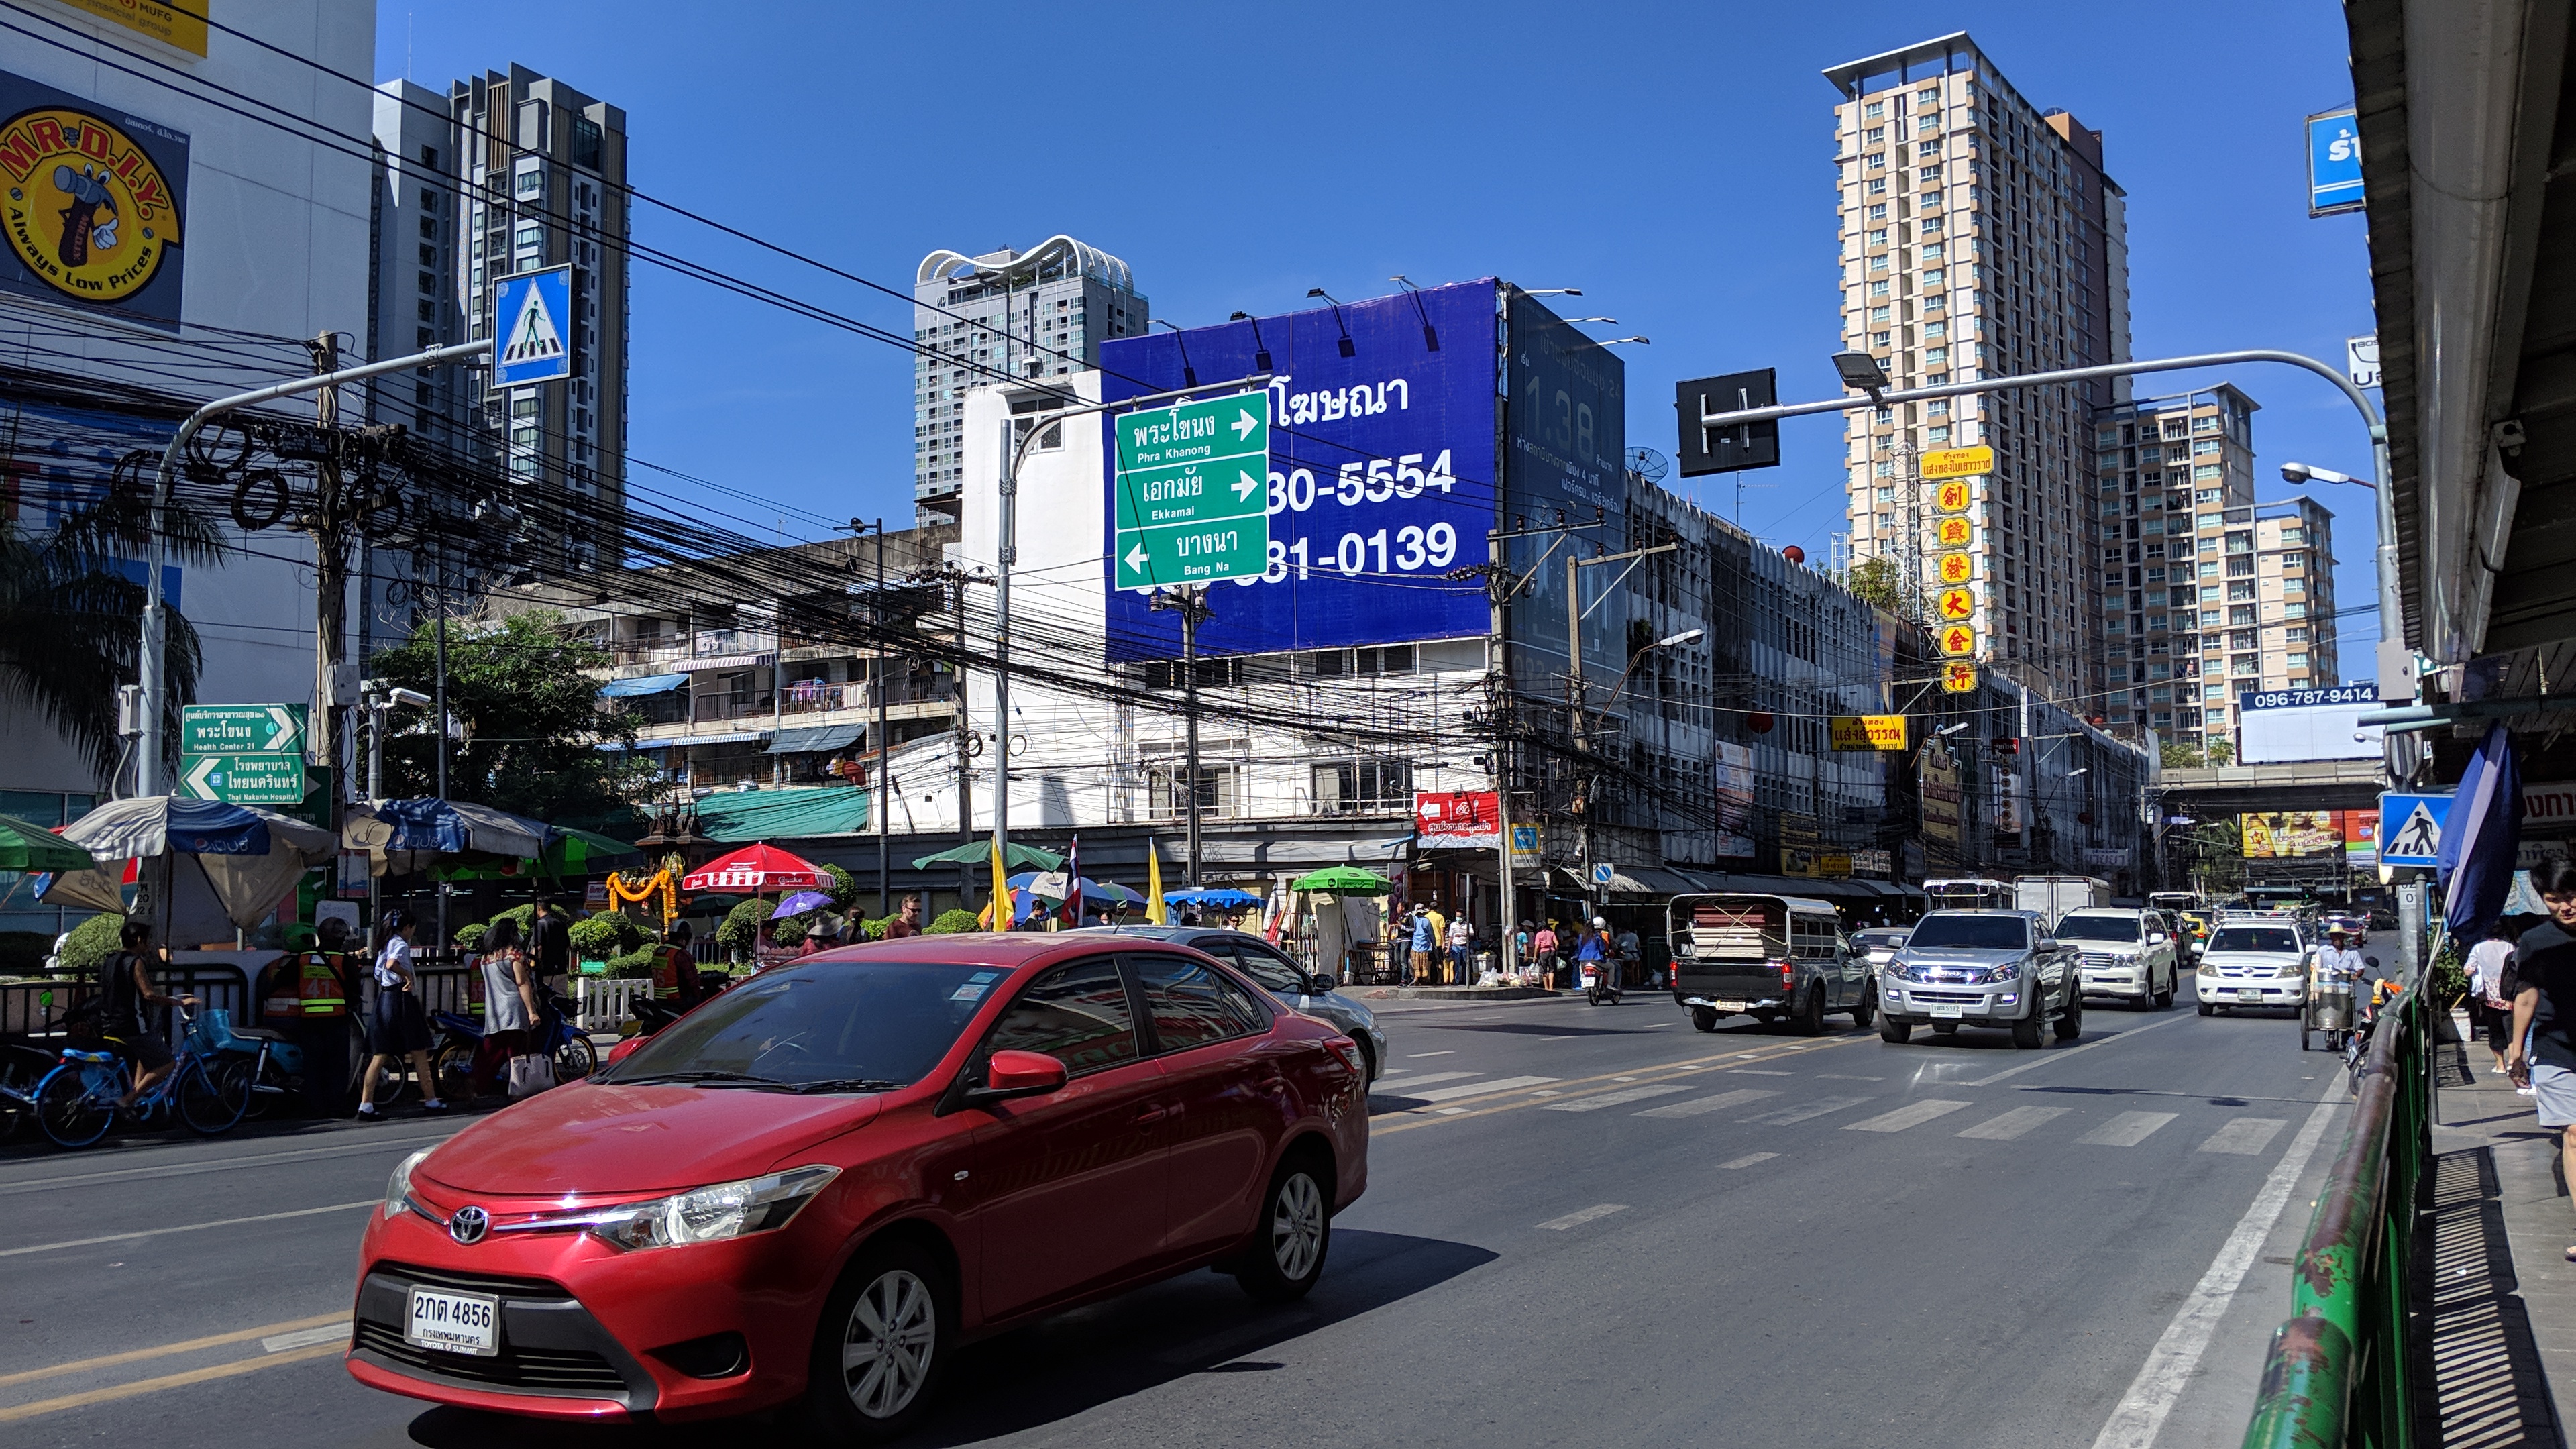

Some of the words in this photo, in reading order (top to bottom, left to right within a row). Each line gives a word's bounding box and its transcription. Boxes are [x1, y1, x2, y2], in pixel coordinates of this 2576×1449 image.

[139, 3, 172, 22] MUFG
[138, 18, 172, 36] group
[9, 207, 59, 276] Always
[65, 271, 103, 291] Low
[108, 246, 152, 289] Prices
[1268, 374, 1409, 428] โฆษณา
[1134, 407, 1215, 447] พระโขนง
[1526, 375, 1594, 464] 1.38
[1138, 449, 1160, 464] Phra
[1165, 445, 1210, 460] Khanong
[1943, 452, 1969, 460] ห้างทอง
[1144, 466, 1202, 502] เอกมัย
[1152, 505, 1195, 520] Ekkamai
[1176, 531, 1238, 557] บางนา
[1184, 563, 1210, 576] Bang
[1216, 561, 1229, 572] Na
[2255, 688, 2373, 708] 096-787-9414
[197, 720, 251, 738] พระโขนง
[233, 757, 290, 771] โรงพยาบาล
[227, 771, 299, 789] ไทยนครินทร์
[227, 794, 241, 802] Thai
[270, 794, 297, 802] Hospital
[2523, 793, 2576, 817] งกา
[305, 979, 331, 998] 41
[452, 1301, 491, 1328] 4856
[421, 1340, 443, 1350] TOYOTA
[452, 1345, 478, 1355] SUMMIT
